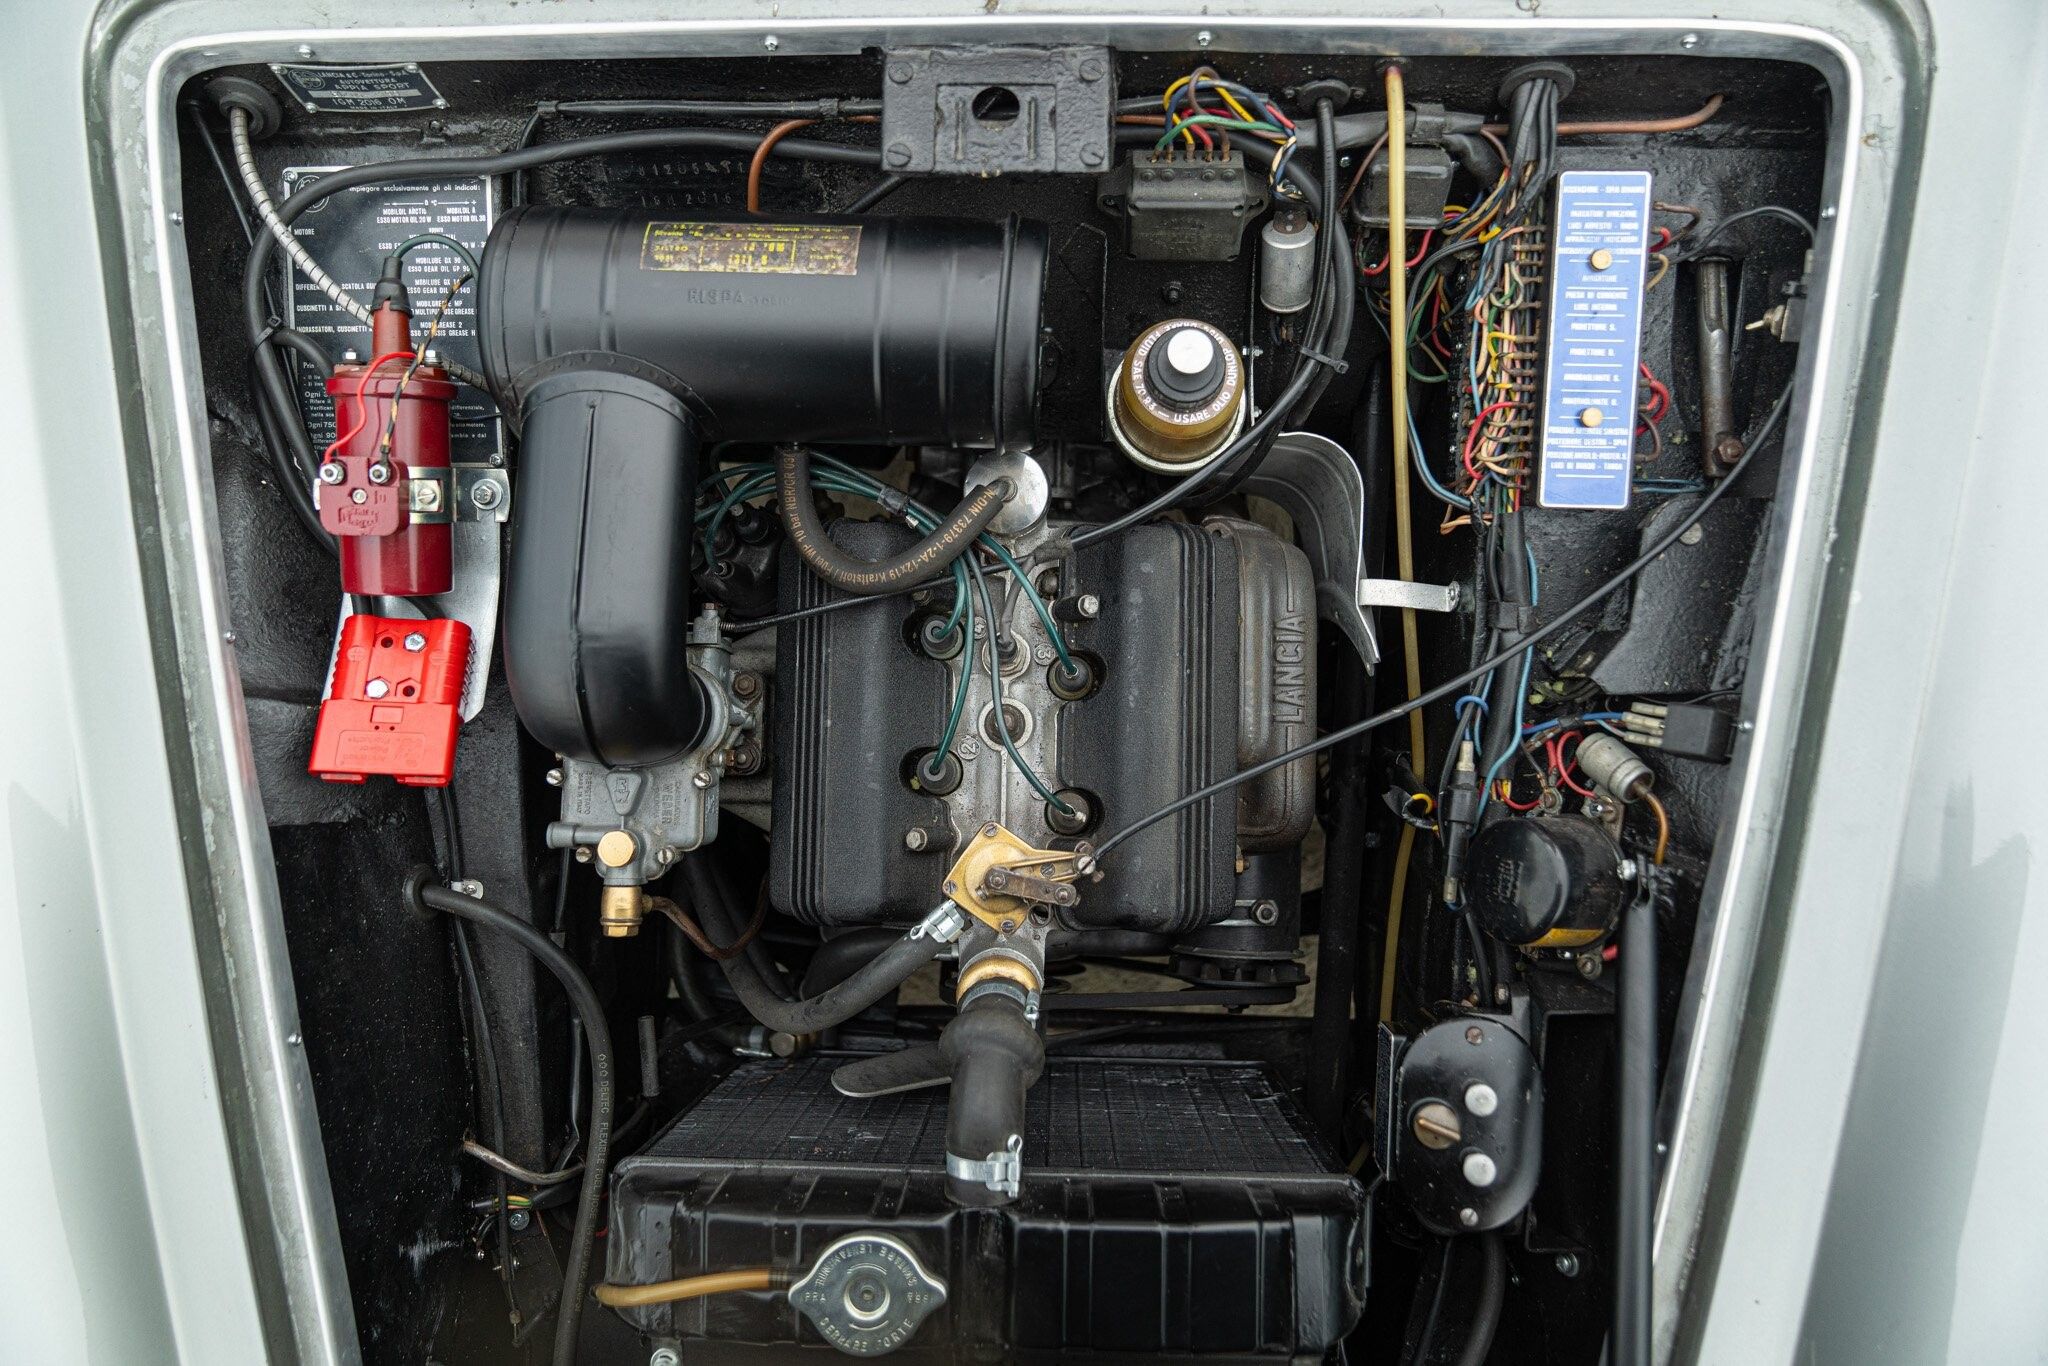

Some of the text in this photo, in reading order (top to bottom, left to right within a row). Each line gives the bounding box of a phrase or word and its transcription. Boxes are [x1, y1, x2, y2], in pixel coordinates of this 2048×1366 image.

[374, 82, 410, 90] SPORT
[358, 98, 382, 106] 2016
[383, 184, 429, 192] esclusivamente
[1139, 331, 1161, 356] FLUID
[1133, 360, 1144, 380] SAE
[1223, 348, 1238, 387] DUNLOP
[1212, 391, 1231, 412] OLIO
[1173, 409, 1211, 423] USARE
[783, 472, 798, 511] NBR/CR
[790, 513, 802, 530] bar
[794, 530, 807, 543] 10
[1273, 614, 1305, 724] LANCIA
[662, 783, 674, 825] WEBER
[597, 1122, 608, 1164] FLEXIBLE
